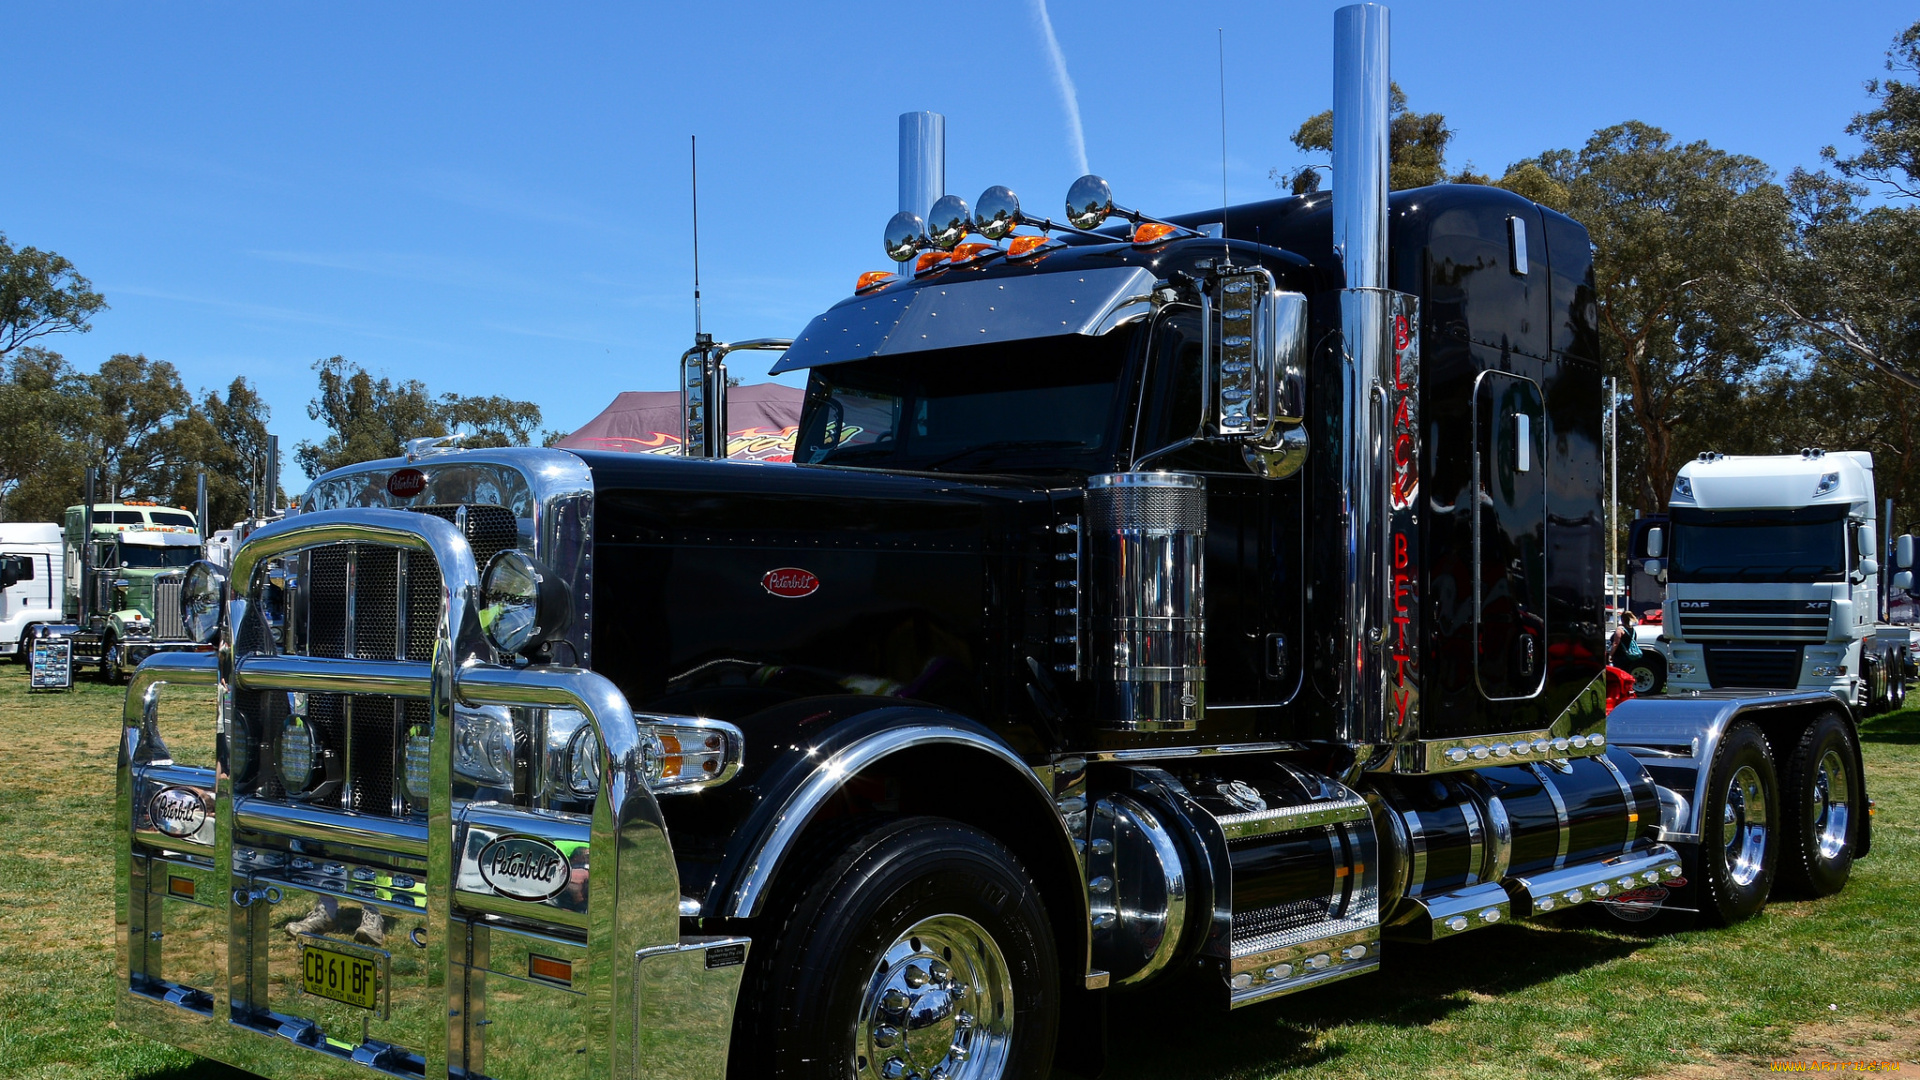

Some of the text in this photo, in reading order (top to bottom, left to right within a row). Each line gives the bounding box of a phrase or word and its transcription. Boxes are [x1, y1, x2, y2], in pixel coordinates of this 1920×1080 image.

[390, 474, 423, 492] Peterbilt
[1393, 315, 1410, 727] BLACK BETTY
[769, 572, 815, 590] Peterbilt
[1680, 601, 1710, 609] DAF
[1804, 601, 1829, 609] XF
[157, 794, 200, 823] Peterbilt
[491, 843, 561, 884] Peterbilt
[310, 984, 366, 1005] NEW SOUTH WALES
